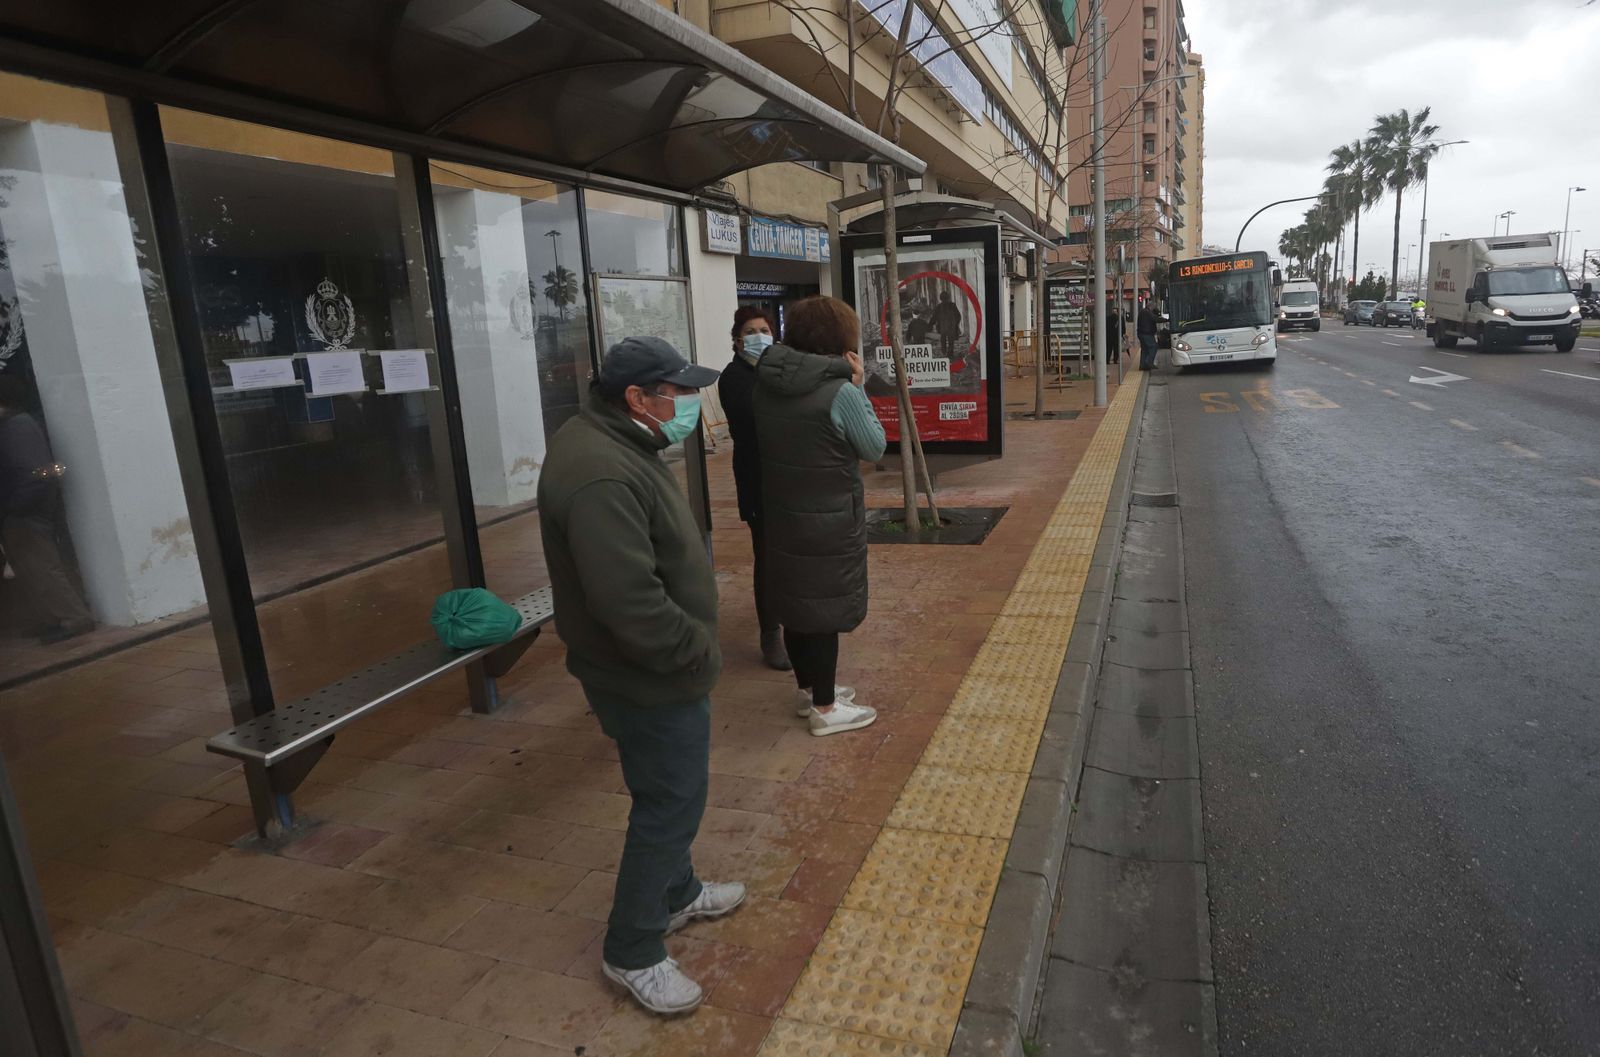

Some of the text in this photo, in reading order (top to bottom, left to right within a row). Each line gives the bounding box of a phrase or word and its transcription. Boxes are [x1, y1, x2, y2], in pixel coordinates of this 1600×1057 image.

[711, 213, 735, 229] Viajes
[711, 228, 738, 242] LUKUS
[1180, 266, 1191, 276] L3
[736, 282, 758, 290] AGENCIA
[758, 283, 766, 291] DE
[905, 347, 929, 359] PARA
[891, 361, 947, 374] SBREVIVIR
[959, 402, 975, 410] SIRIA
